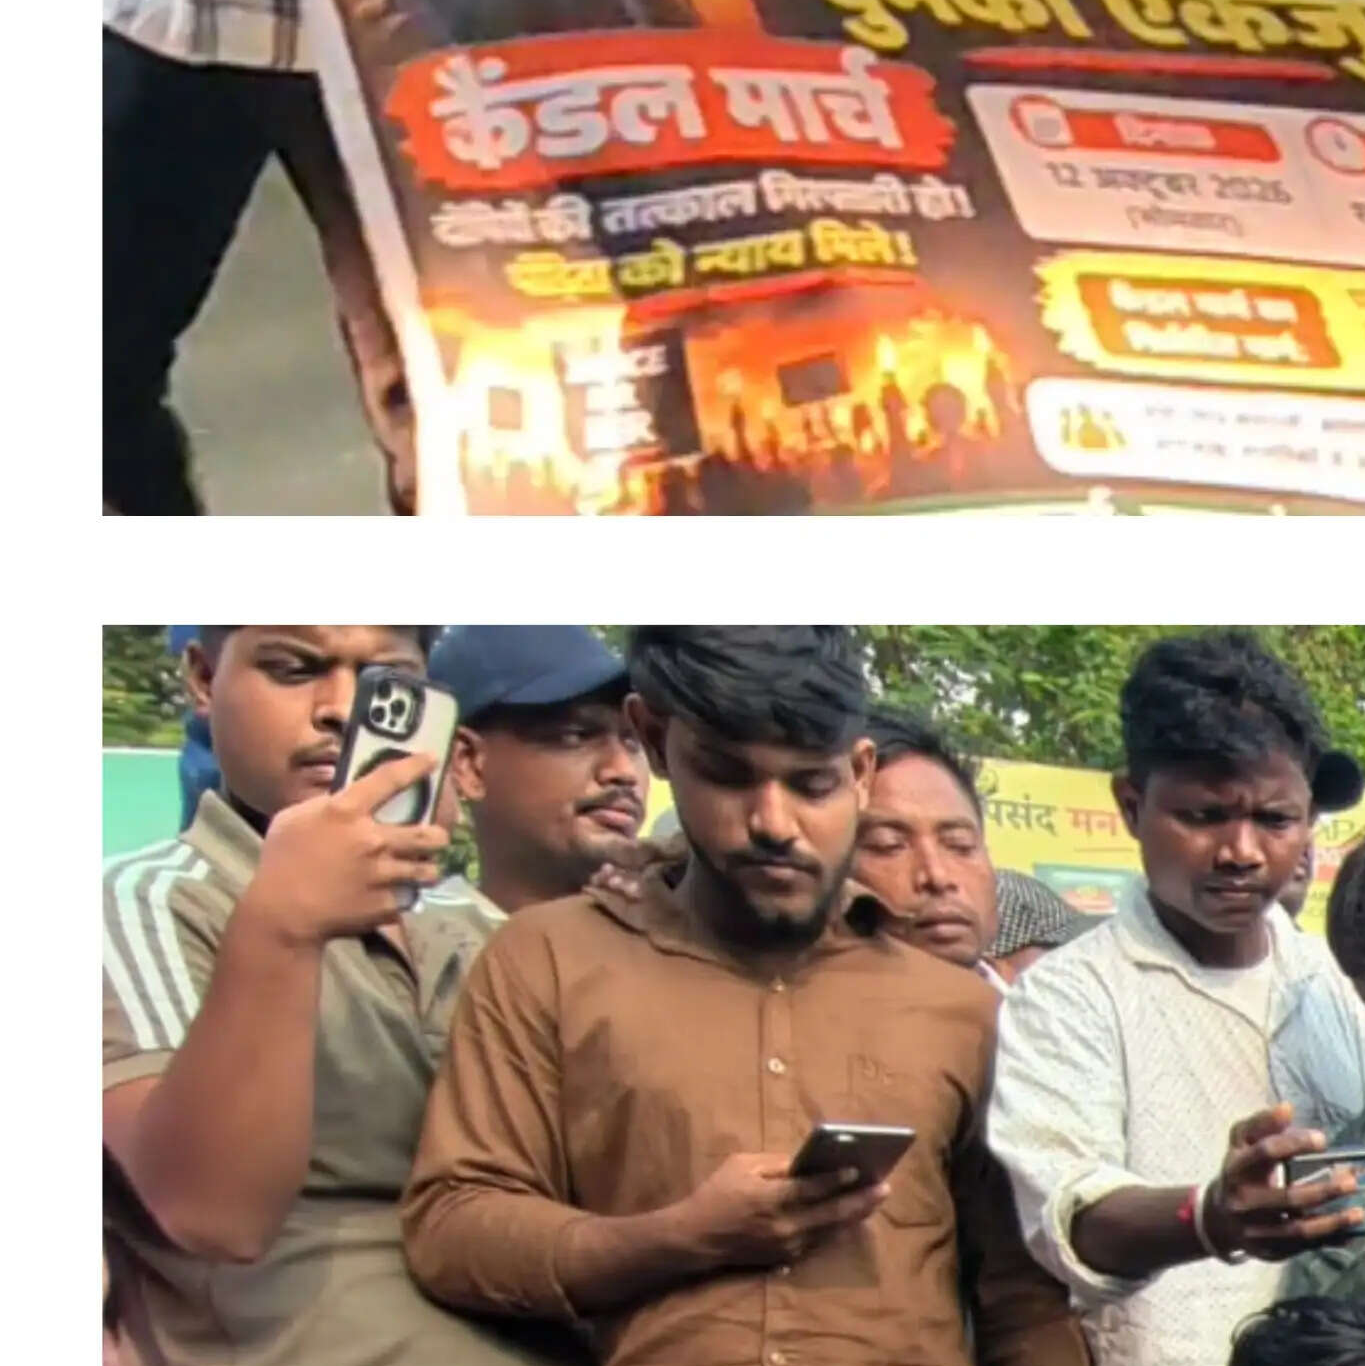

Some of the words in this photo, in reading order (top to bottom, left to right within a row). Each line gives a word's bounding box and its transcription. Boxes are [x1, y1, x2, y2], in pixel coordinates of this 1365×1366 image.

[430, 51, 707, 171] कैंडल
[708, 44, 905, 149] मार्च
[602, 179, 760, 235] तत्काल
[1045, 160, 1085, 189] 12
[1205, 171, 1294, 206] 2026
[618, 242, 688, 288] को
[694, 227, 806, 273] न्याय
